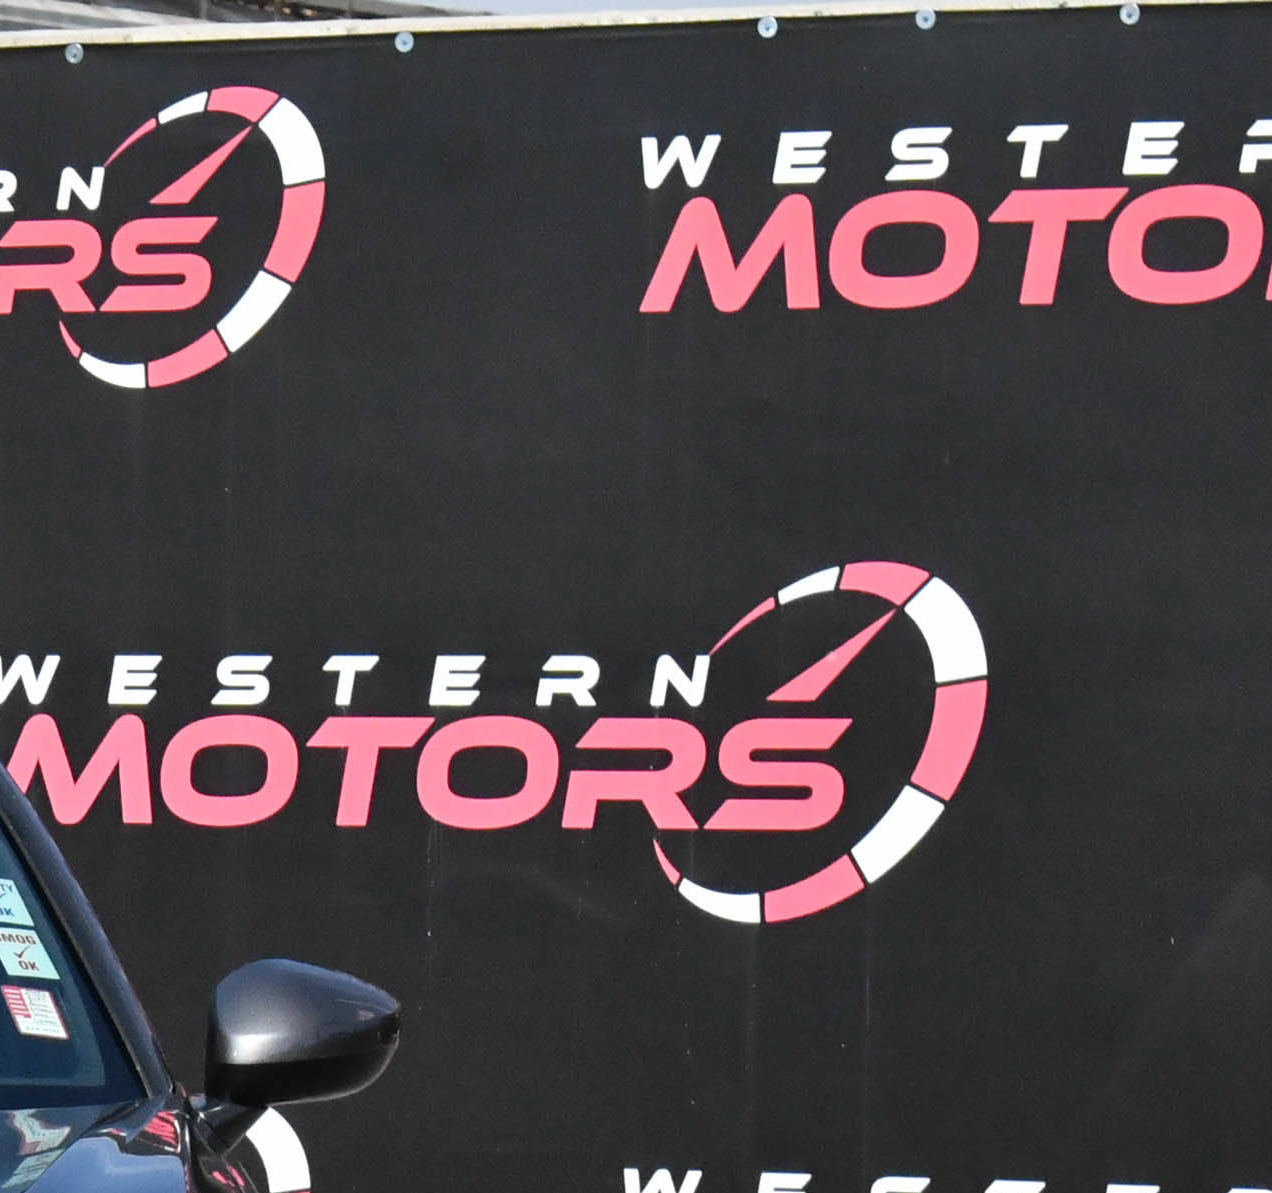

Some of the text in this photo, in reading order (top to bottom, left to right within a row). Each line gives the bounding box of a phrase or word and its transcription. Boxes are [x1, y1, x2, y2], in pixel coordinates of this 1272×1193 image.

[638, 183, 1272, 314] MOTO
[6, 713, 853, 831] MOTORS
[18, 960, 40, 971] OK
